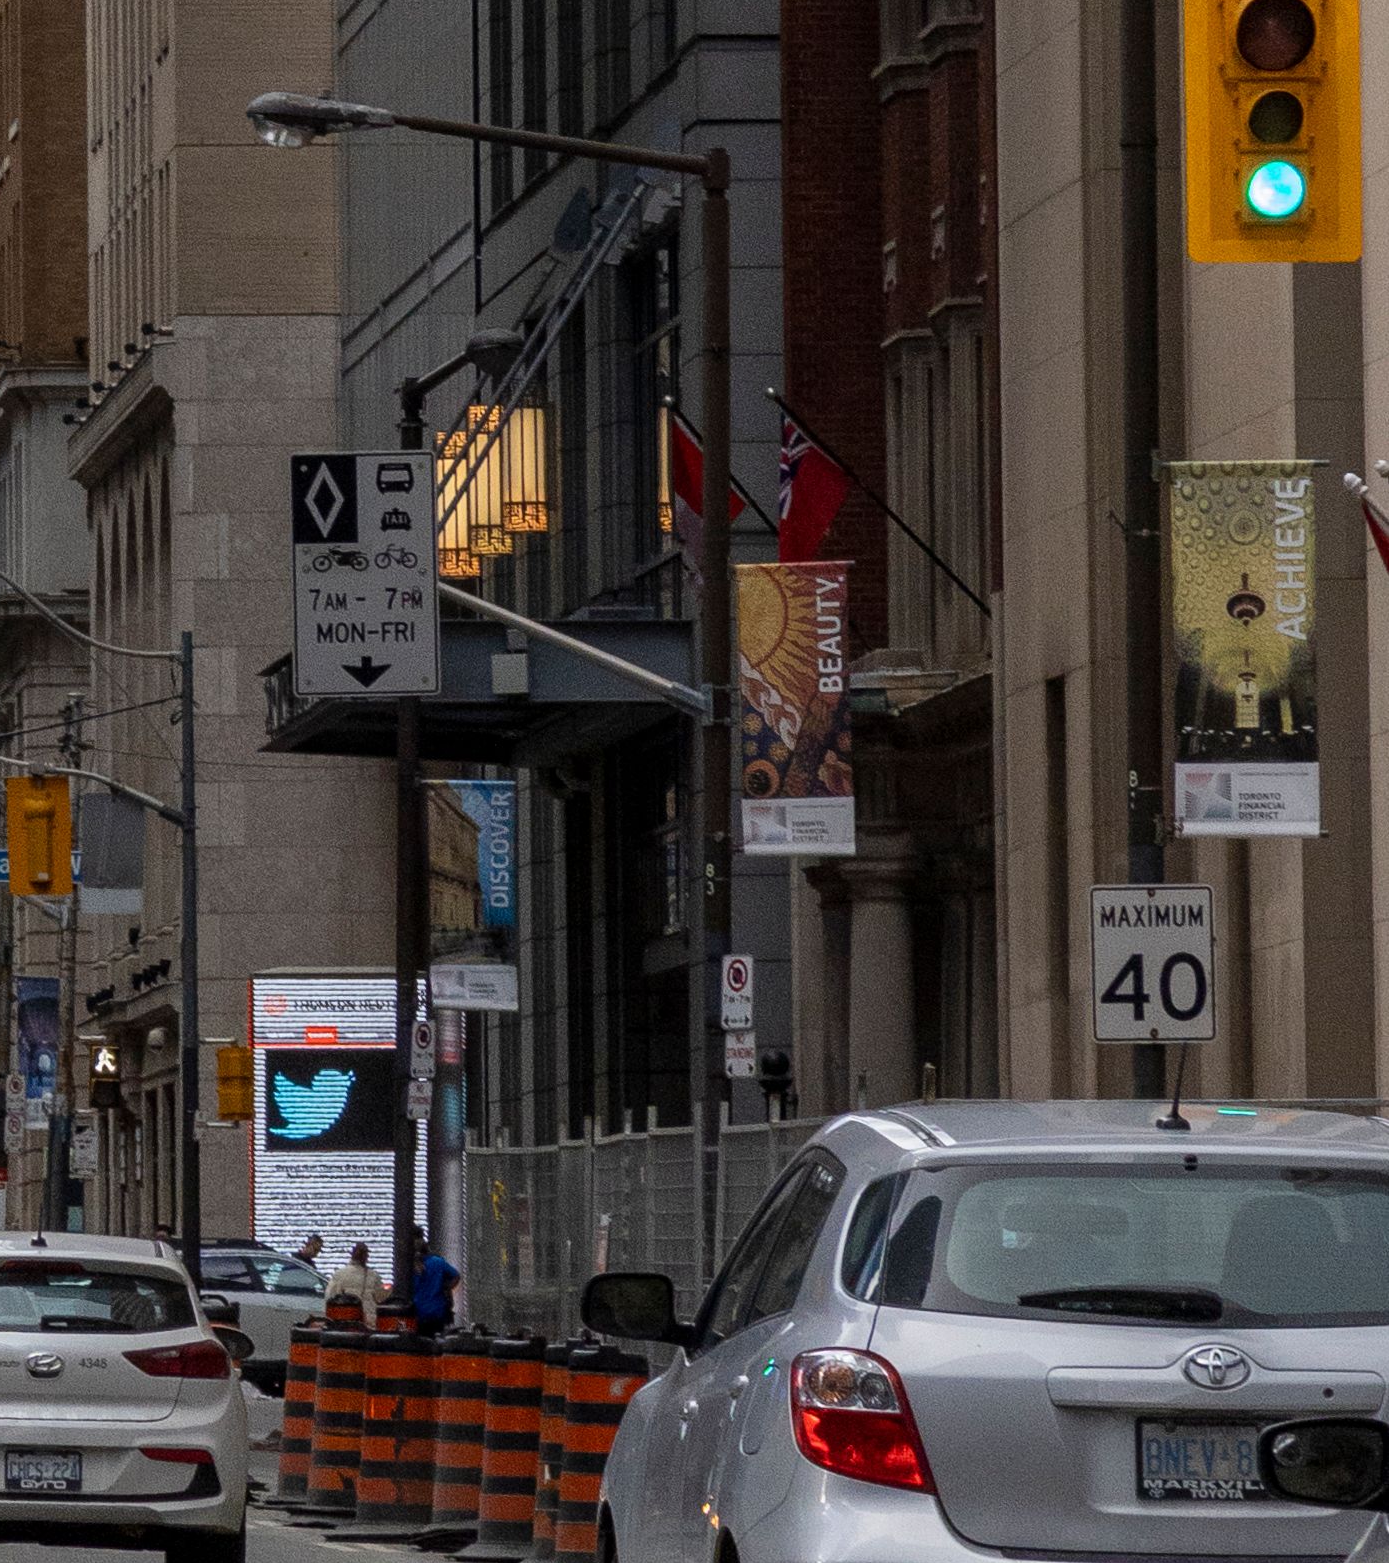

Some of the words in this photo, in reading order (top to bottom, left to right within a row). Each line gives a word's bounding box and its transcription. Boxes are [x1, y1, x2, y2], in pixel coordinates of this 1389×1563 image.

[384, 514, 408, 526] TAXI
[1275, 478, 1311, 641] ACHIEVE
[317, 621, 415, 644] MON-FRI
[1238, 792, 1281, 801] TORONTO
[1238, 802, 1286, 810] FINANCIAL
[1238, 811, 1279, 820] DISTRICT
[490, 791, 511, 909] DISCOVER
[1100, 904, 1204, 928] MAXIMUM
[1100, 951, 1208, 1022] 40
[1143, 1479, 1265, 1490] MARKVIL
[1190, 1488, 1245, 1500] TOYOTA
